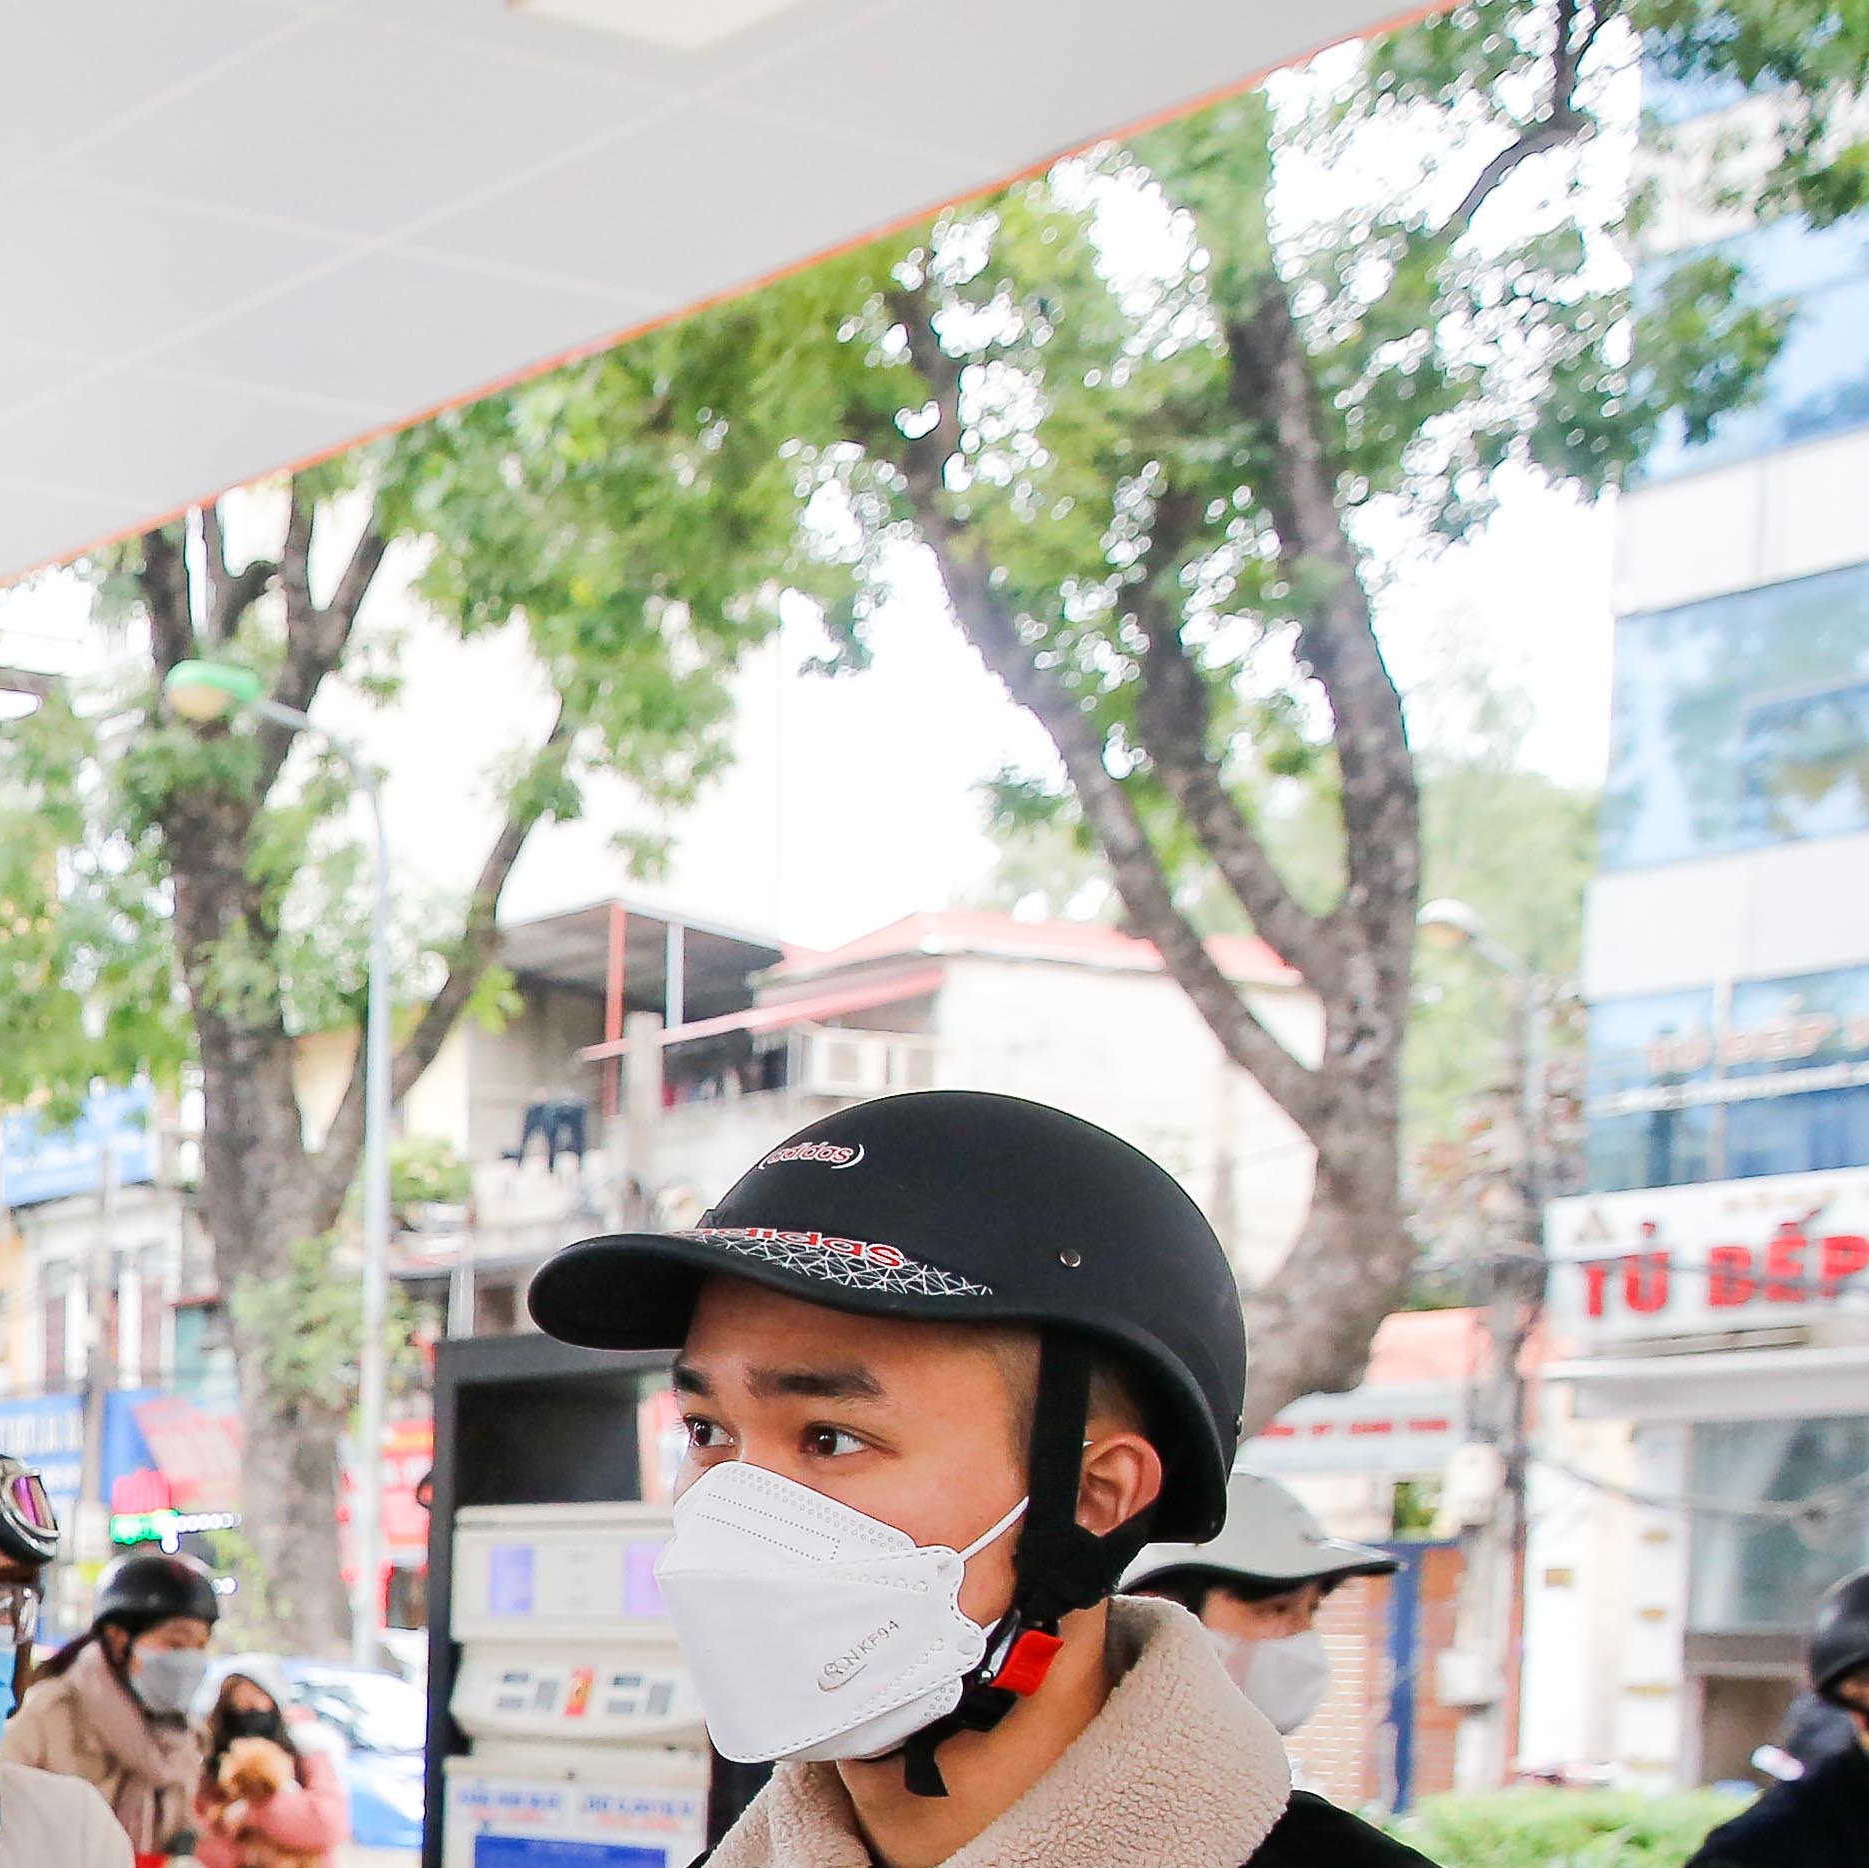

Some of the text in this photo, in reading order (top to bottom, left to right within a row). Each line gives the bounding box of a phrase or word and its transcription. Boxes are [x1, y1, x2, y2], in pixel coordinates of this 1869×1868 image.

[765, 1141, 855, 1164] adidas
[1584, 1208, 1869, 1319] TỦ BẾP
[857, 1620, 900, 1654] KF94
